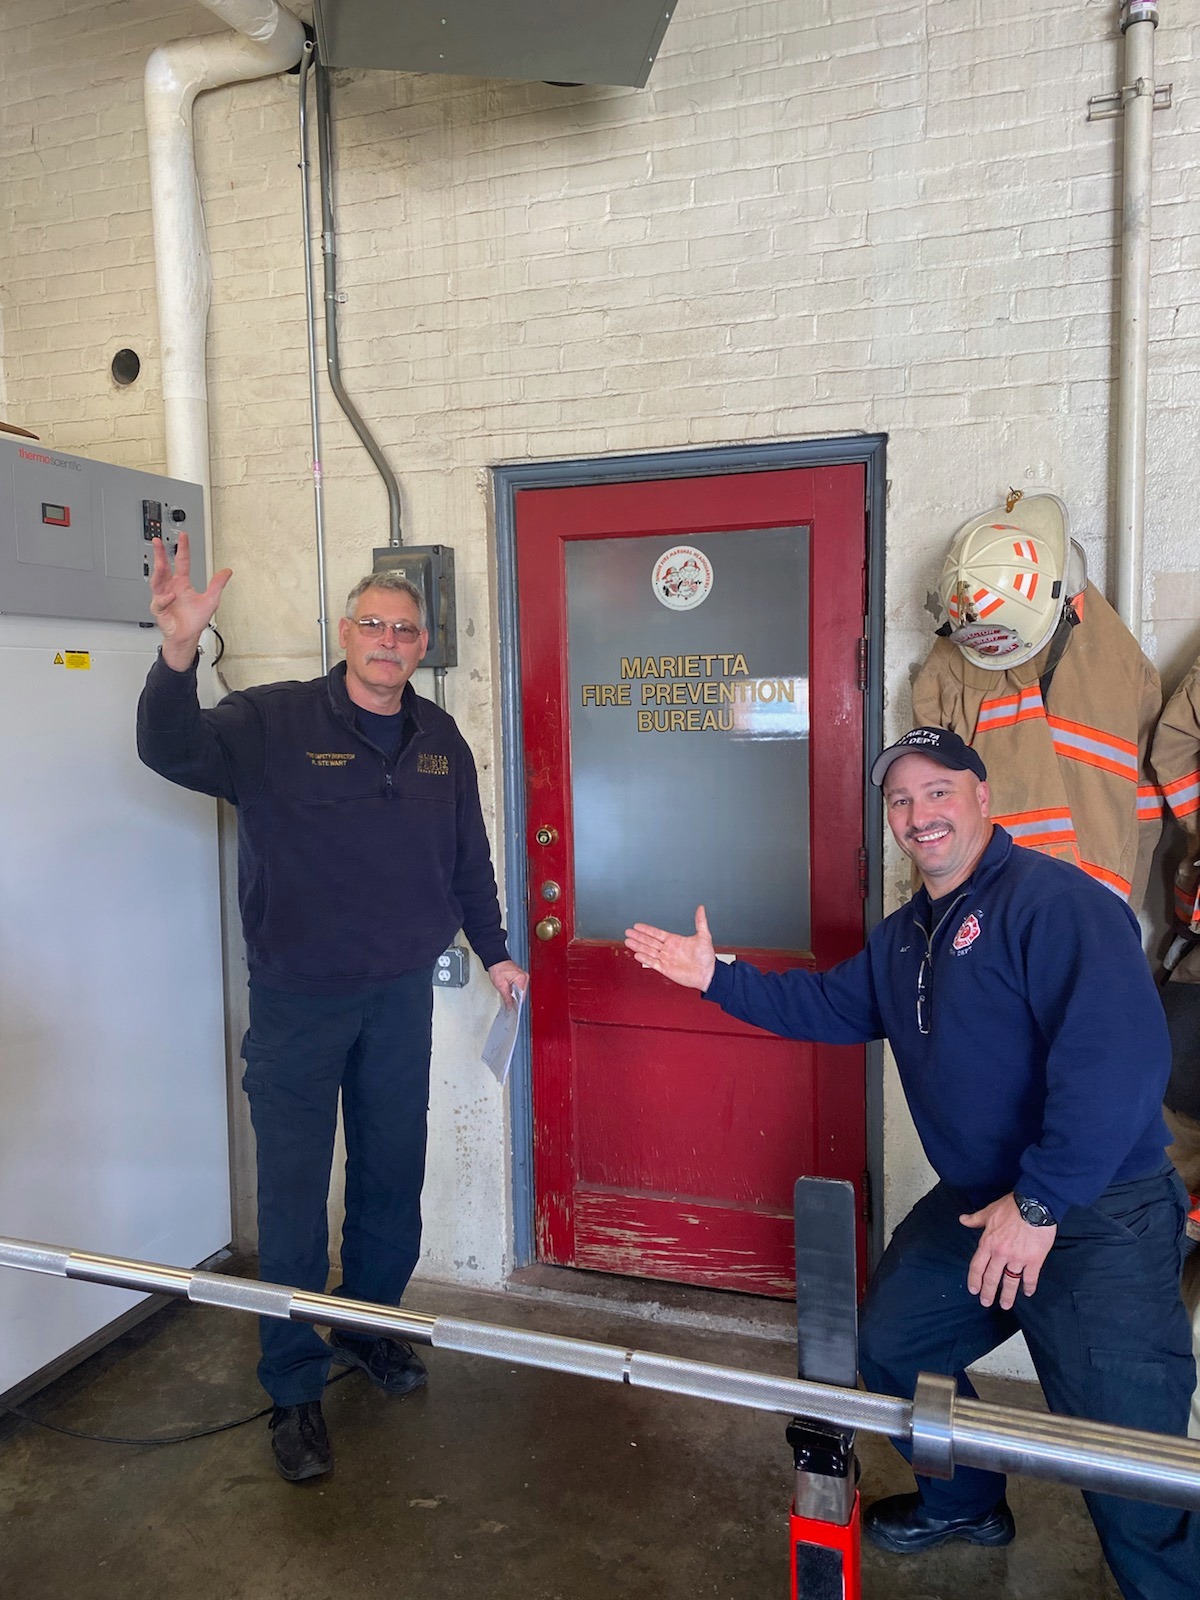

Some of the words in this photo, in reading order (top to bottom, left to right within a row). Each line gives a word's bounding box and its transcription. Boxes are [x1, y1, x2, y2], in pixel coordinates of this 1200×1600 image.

[661, 555, 670, 565] FIRE
[669, 549, 693, 557] MARSHAL
[620, 653, 750, 679] MARIETTA
[581, 684, 632, 706] FIRE
[641, 680, 795, 705] PREVENTION
[637, 708, 734, 732] BUREAU
[909, 737, 940, 746] DEPT.
